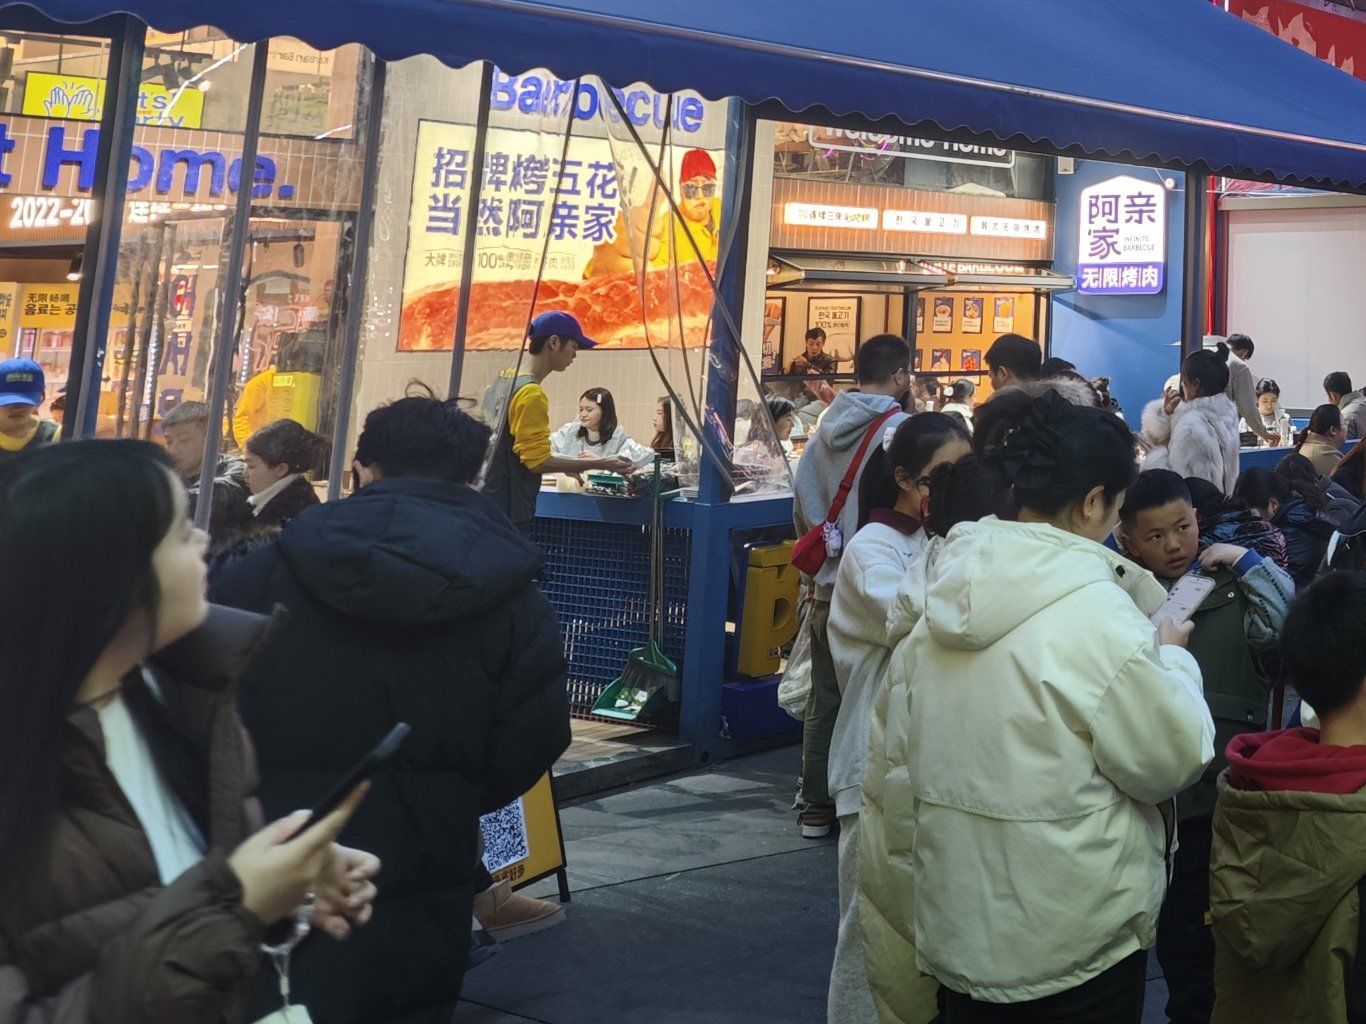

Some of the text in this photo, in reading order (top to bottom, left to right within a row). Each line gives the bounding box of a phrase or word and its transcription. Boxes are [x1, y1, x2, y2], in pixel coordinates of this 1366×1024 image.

[42, 126, 294, 200] Home.
[426, 193, 616, 242] 当然阿亲家
[1088, 191, 1157, 225] 阿亲
[1087, 226, 1122, 260] 家
[1081, 267, 1159, 289] 无限烤肉
